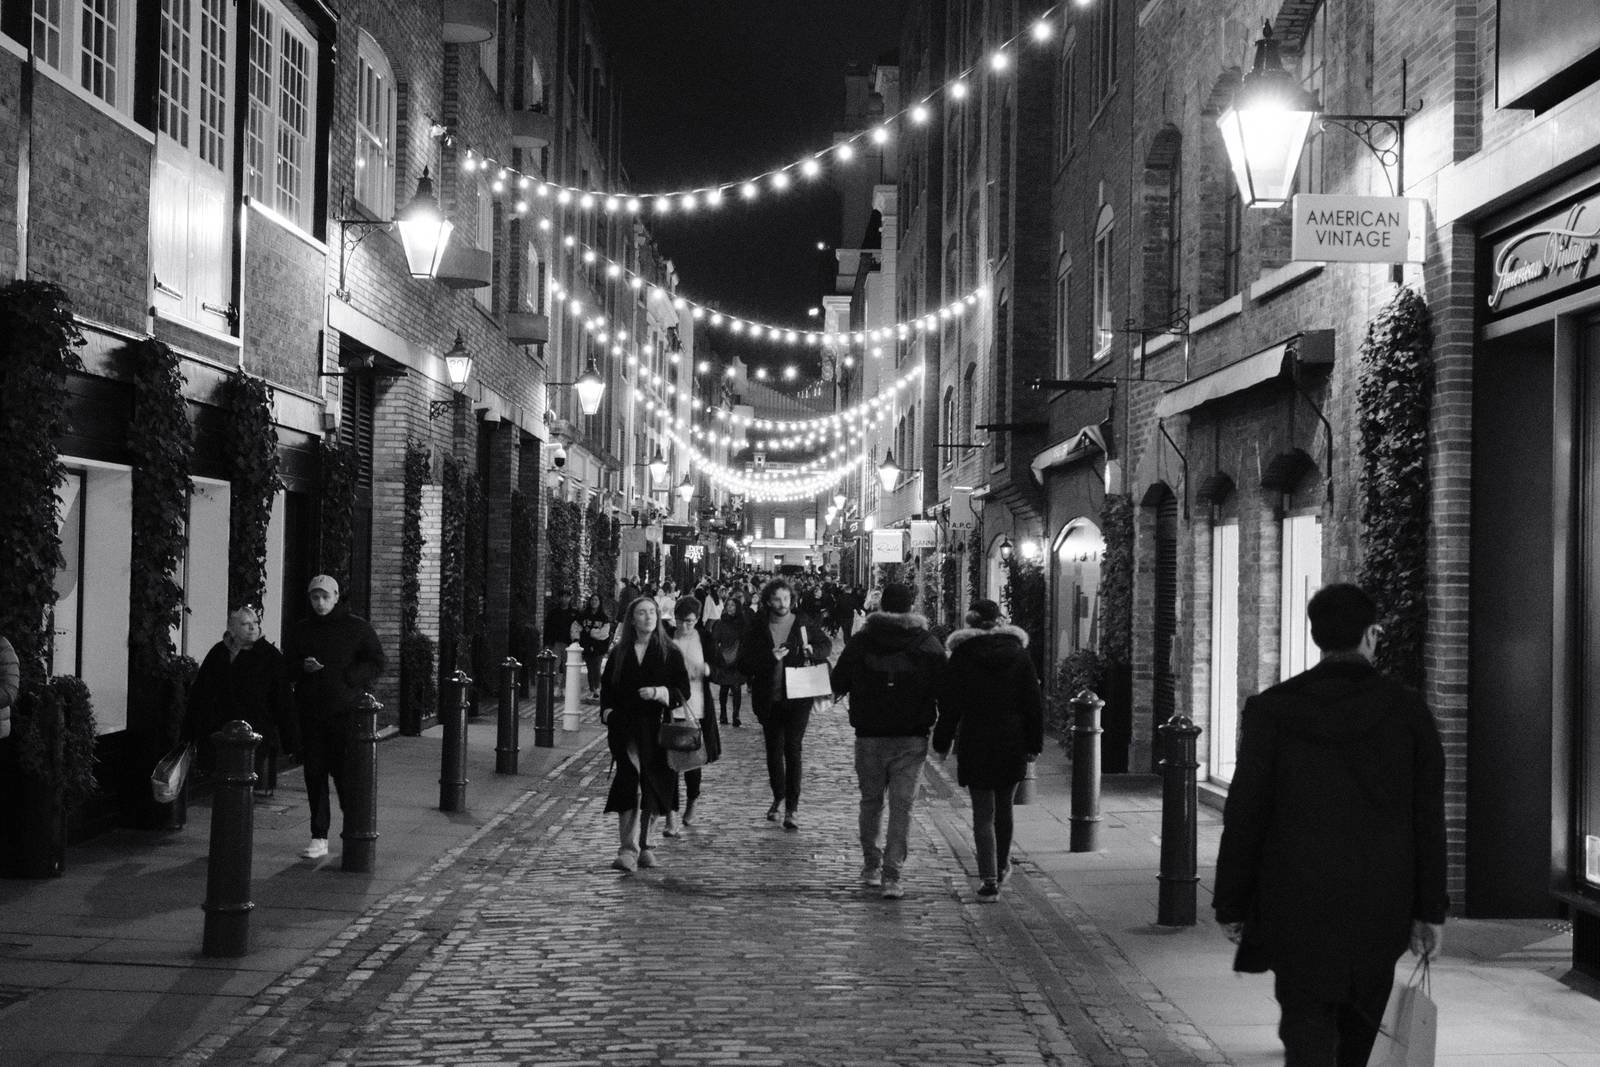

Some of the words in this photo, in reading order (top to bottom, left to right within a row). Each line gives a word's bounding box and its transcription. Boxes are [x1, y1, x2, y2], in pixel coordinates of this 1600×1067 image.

[1306, 209, 1400, 227] AMERICAN
[1315, 229, 1392, 247] VINTAGE
[1543, 203, 1592, 279] Vintage
